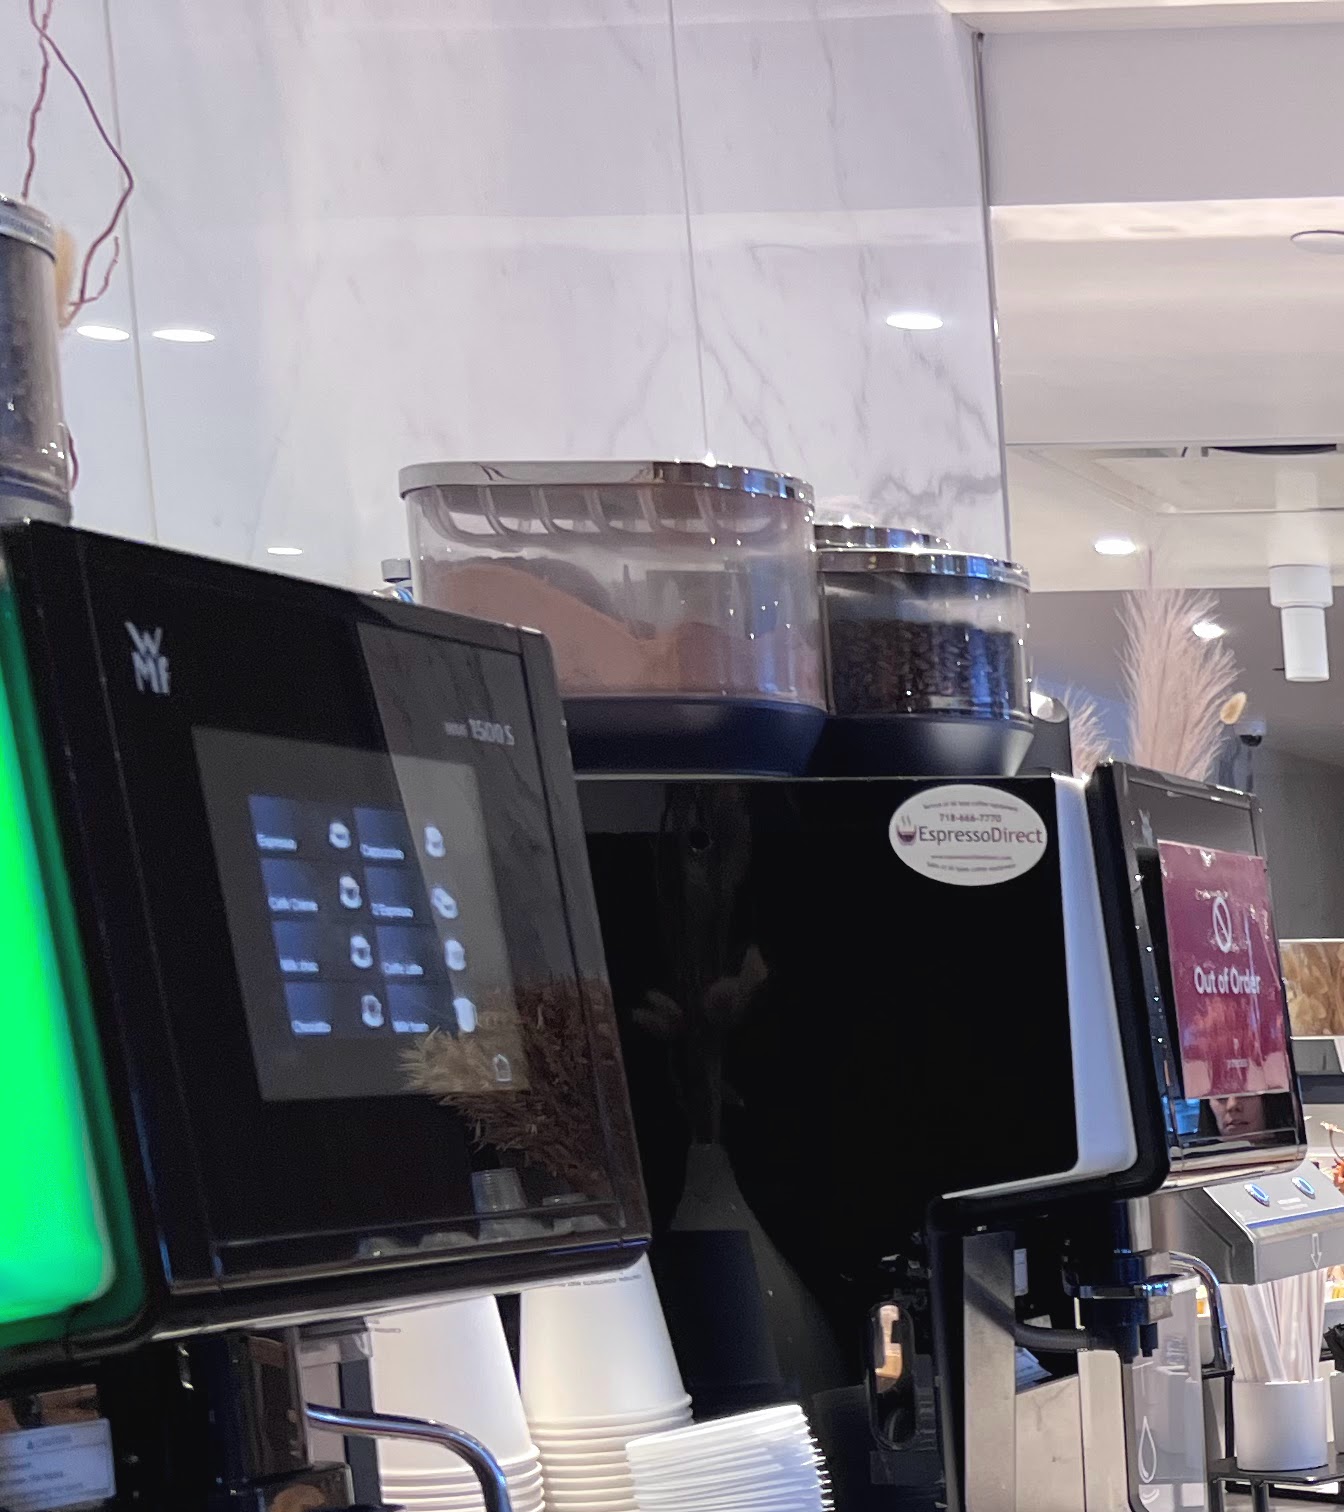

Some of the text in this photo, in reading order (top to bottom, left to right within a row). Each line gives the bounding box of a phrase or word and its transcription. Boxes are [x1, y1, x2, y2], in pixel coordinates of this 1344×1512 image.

[918, 826, 1044, 846] EspressoDirect
[1194, 966, 1261, 994] Out of Order
